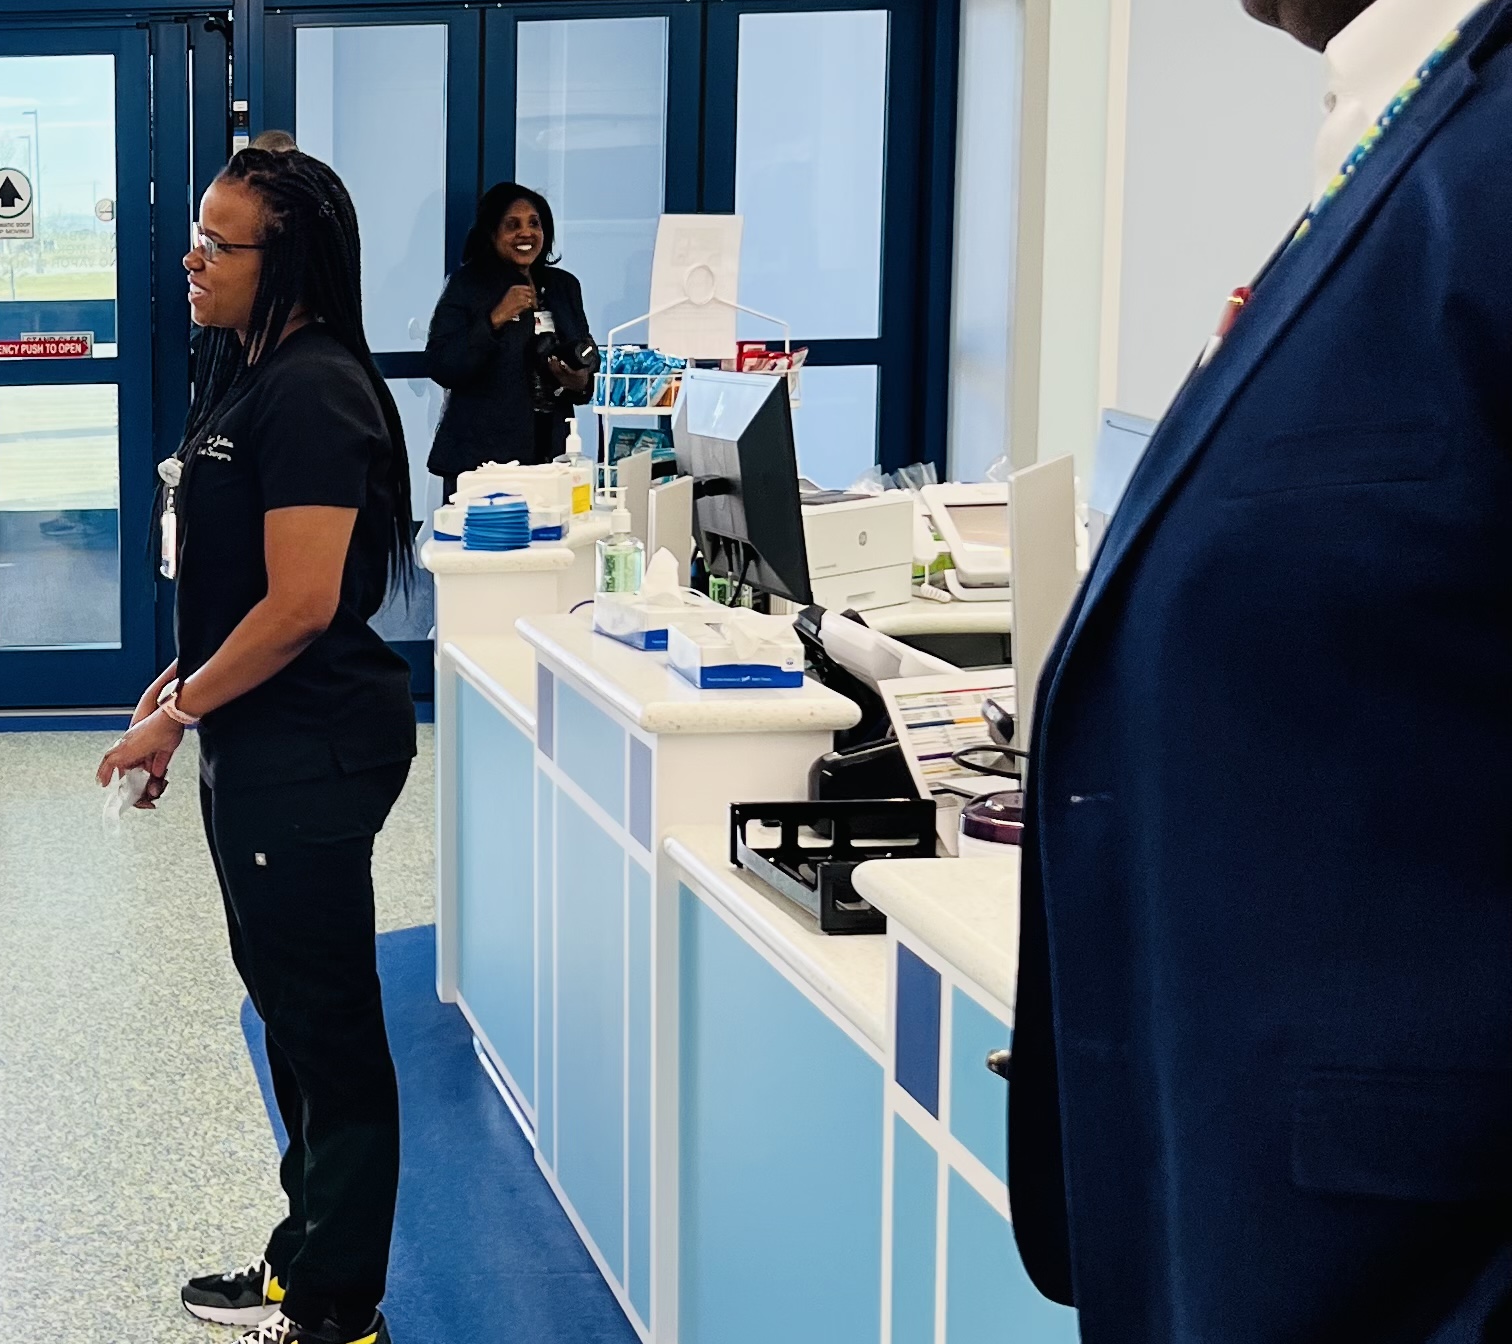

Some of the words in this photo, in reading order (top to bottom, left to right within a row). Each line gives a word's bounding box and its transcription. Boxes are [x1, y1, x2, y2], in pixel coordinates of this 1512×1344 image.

[20, 343, 44, 354] PUSH
[45, 343, 56, 354] TO
[57, 342, 82, 354] OPEN
